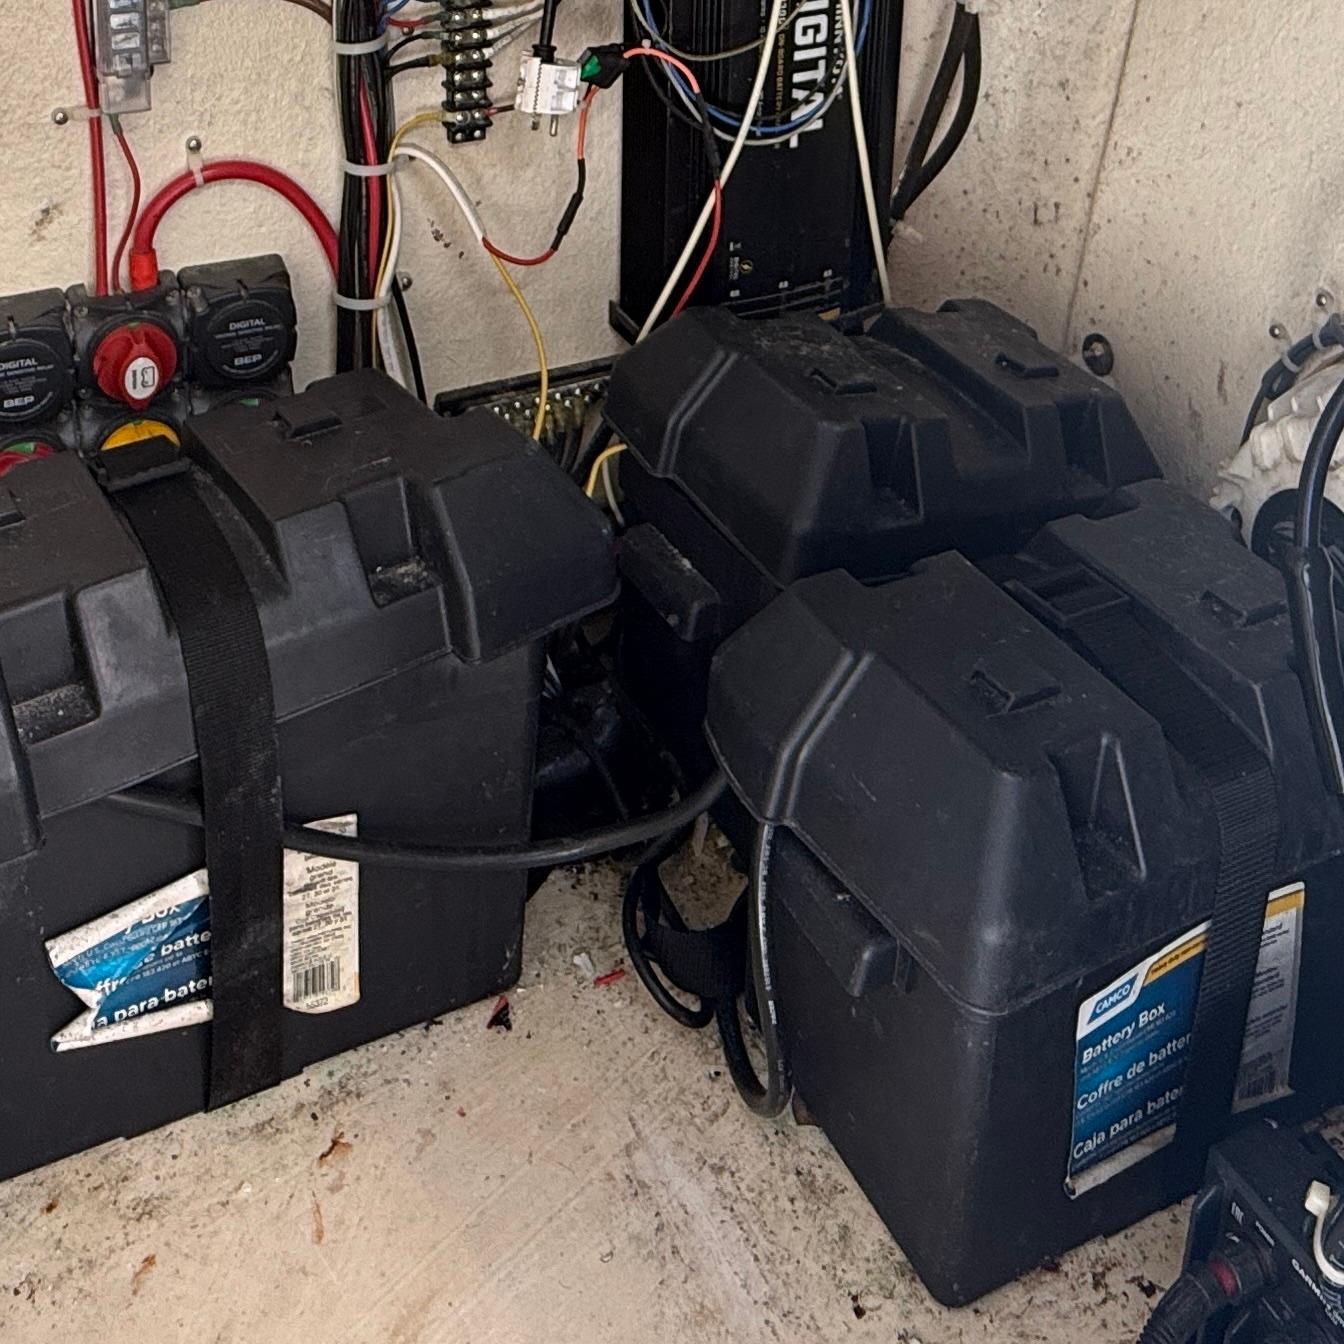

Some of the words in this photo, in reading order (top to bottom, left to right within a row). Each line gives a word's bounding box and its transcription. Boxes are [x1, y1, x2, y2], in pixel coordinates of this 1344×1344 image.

[229, 318, 265, 330] DIGITAL
[234, 354, 262, 365] BEP
[4, 395, 34, 408] BEP
[161, 930, 212, 956] batte
[114, 996, 159, 1022] para
[164, 976, 213, 1003] bater
[1095, 984, 1131, 1014] CAMCO
[1081, 1021, 1135, 1065] Battery
[1138, 1002, 1166, 1028] Box
[1077, 1074, 1123, 1110] Coffre
[1127, 1060, 1145, 1080] de
[1149, 1033, 1192, 1066] batter
[1073, 1130, 1106, 1160] Caja
[1110, 1109, 1143, 1138] para
[1147, 1086, 1184, 1115] bater
